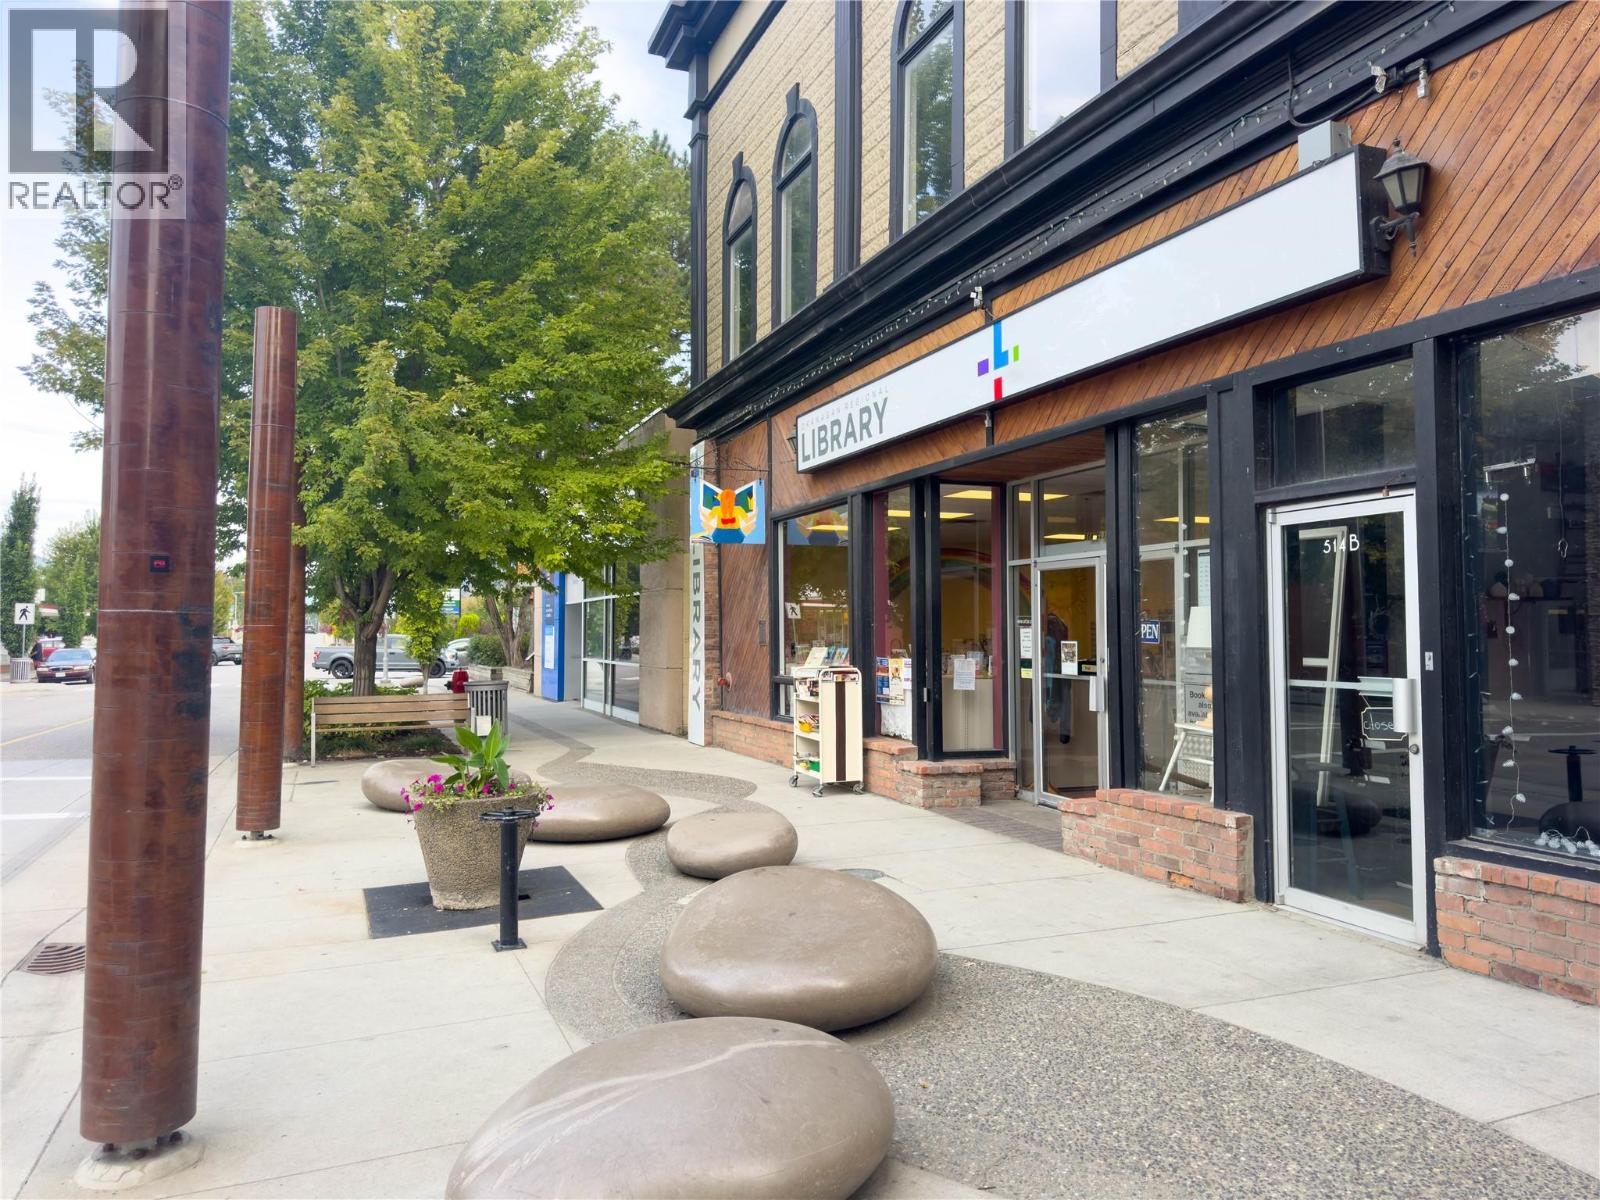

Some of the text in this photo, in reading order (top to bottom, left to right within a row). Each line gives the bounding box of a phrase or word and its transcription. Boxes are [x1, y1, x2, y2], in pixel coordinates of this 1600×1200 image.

[802, 397, 888, 462] LIBRARY
[1140, 623, 1160, 640] PEN
[1189, 690, 1207, 700] Book
